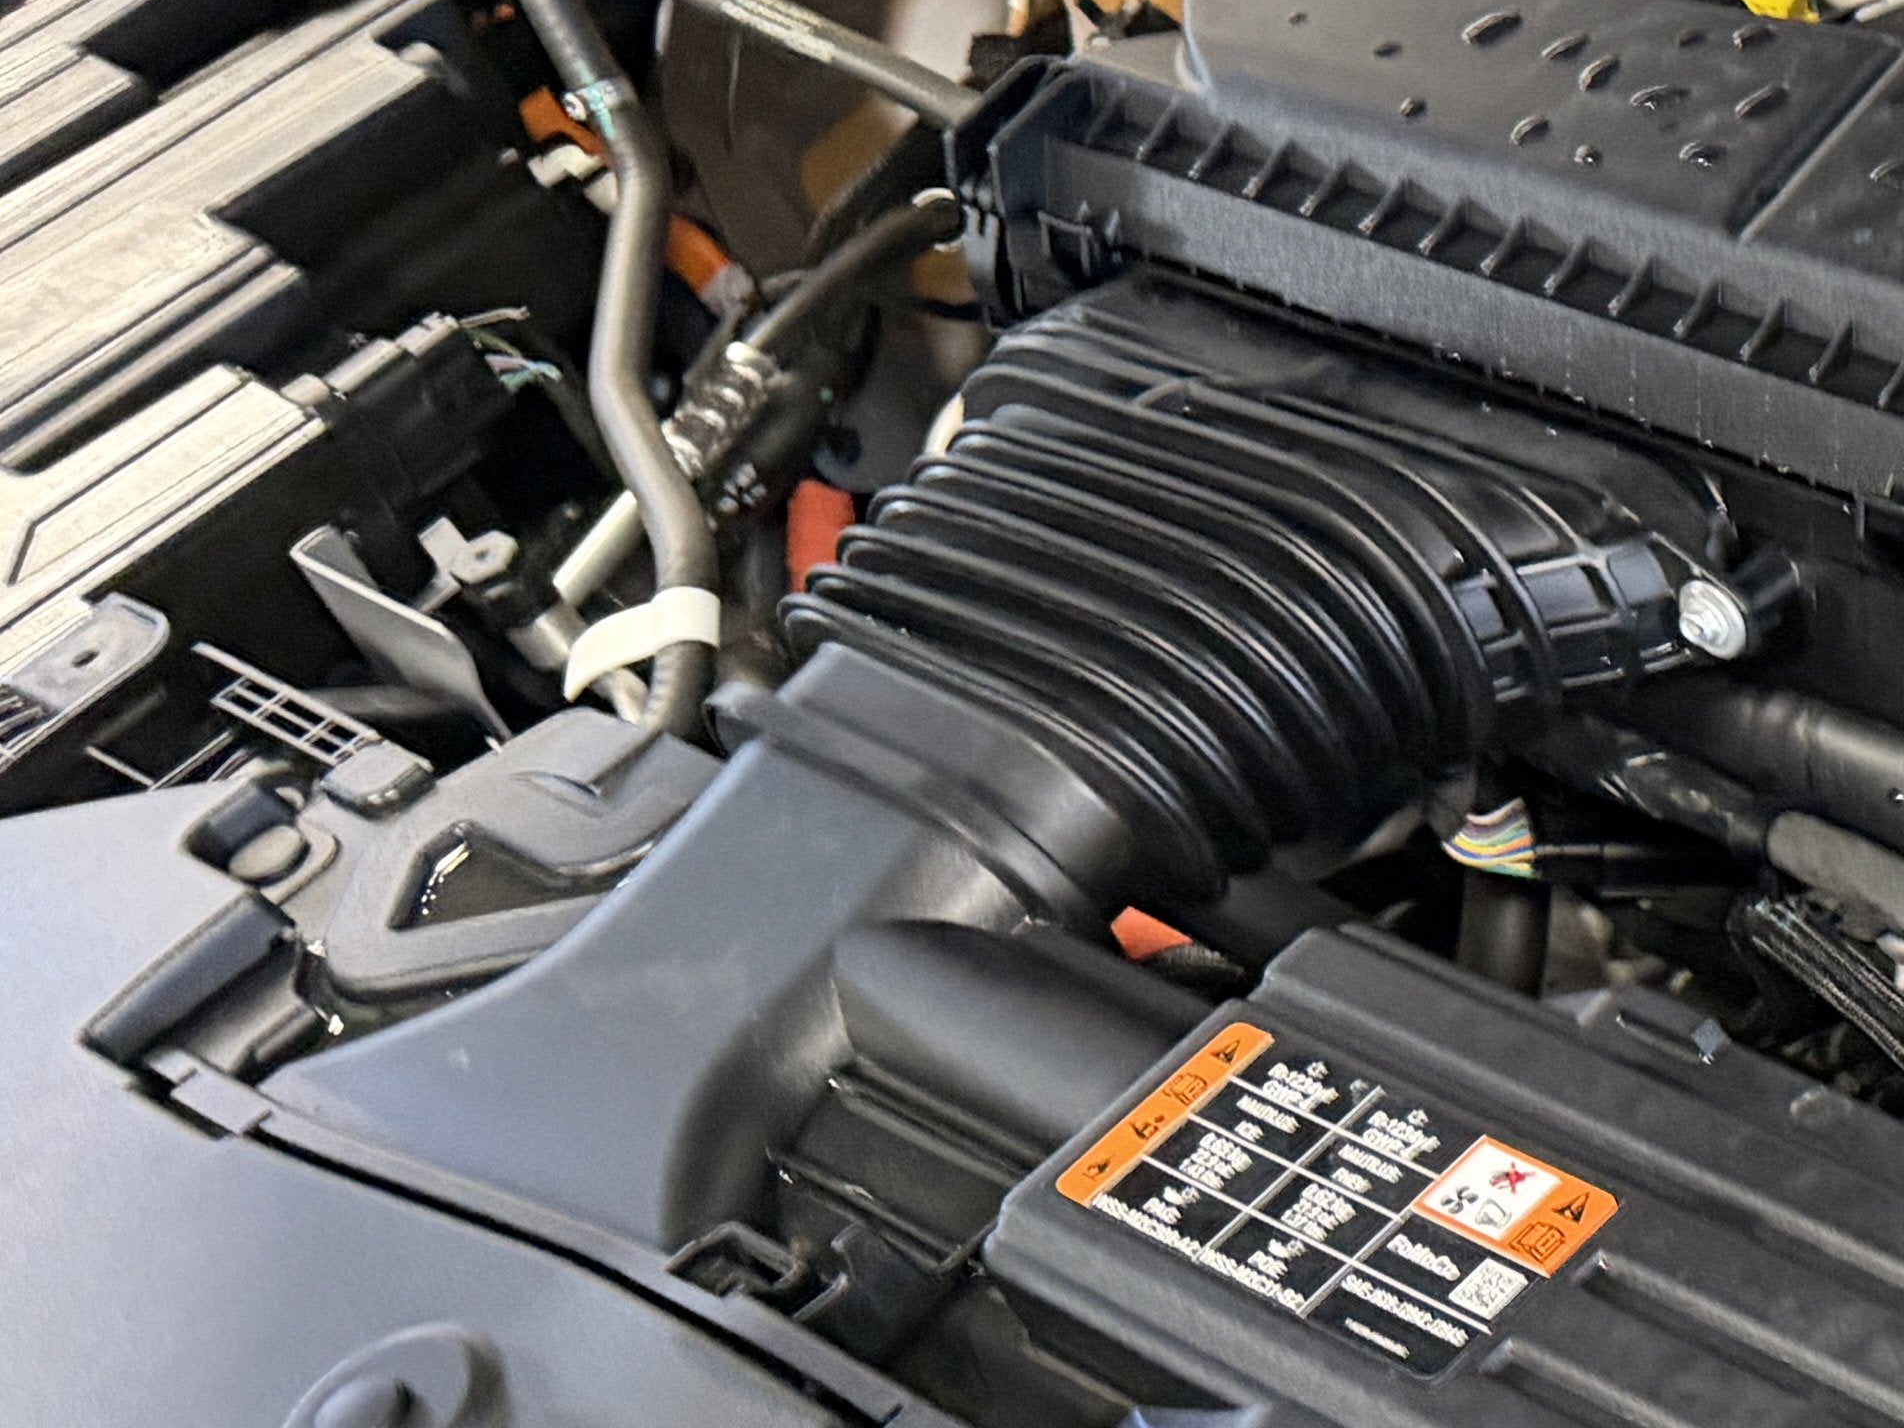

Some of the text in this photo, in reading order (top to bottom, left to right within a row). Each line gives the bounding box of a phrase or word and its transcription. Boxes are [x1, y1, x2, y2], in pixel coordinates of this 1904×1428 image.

[1237, 1095, 1298, 1133] NAUTILUS
[1338, 1144, 1402, 1183] NAUTILUS
[1387, 1234, 1460, 1280] FoMoCo
